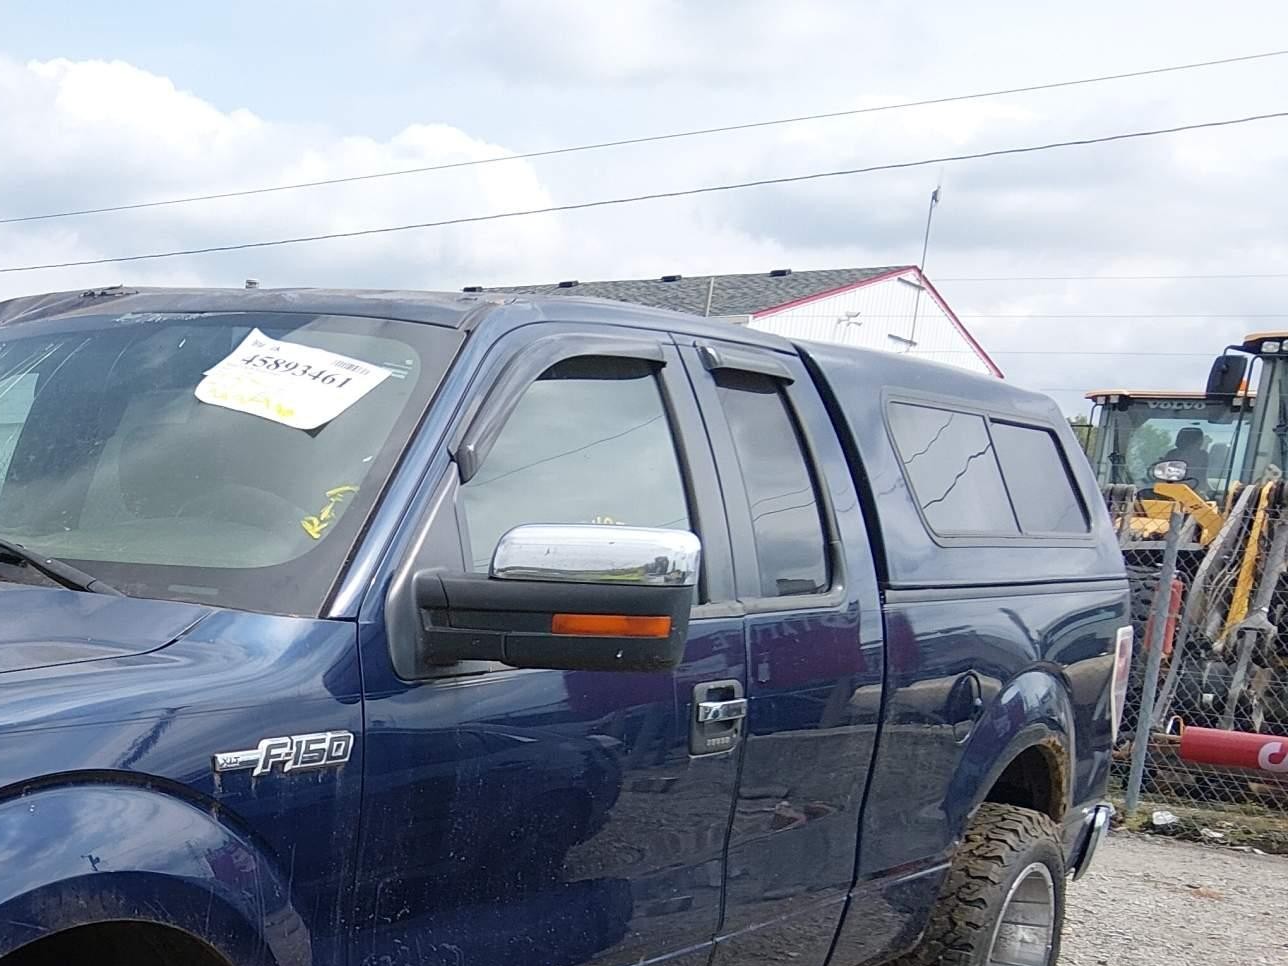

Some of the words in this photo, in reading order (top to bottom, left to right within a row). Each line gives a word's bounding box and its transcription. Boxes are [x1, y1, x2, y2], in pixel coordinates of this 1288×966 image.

[241, 353, 353, 389] 45893461
[1147, 400, 1207, 410] VOLVO
[252, 729, 355, 776] F-150
